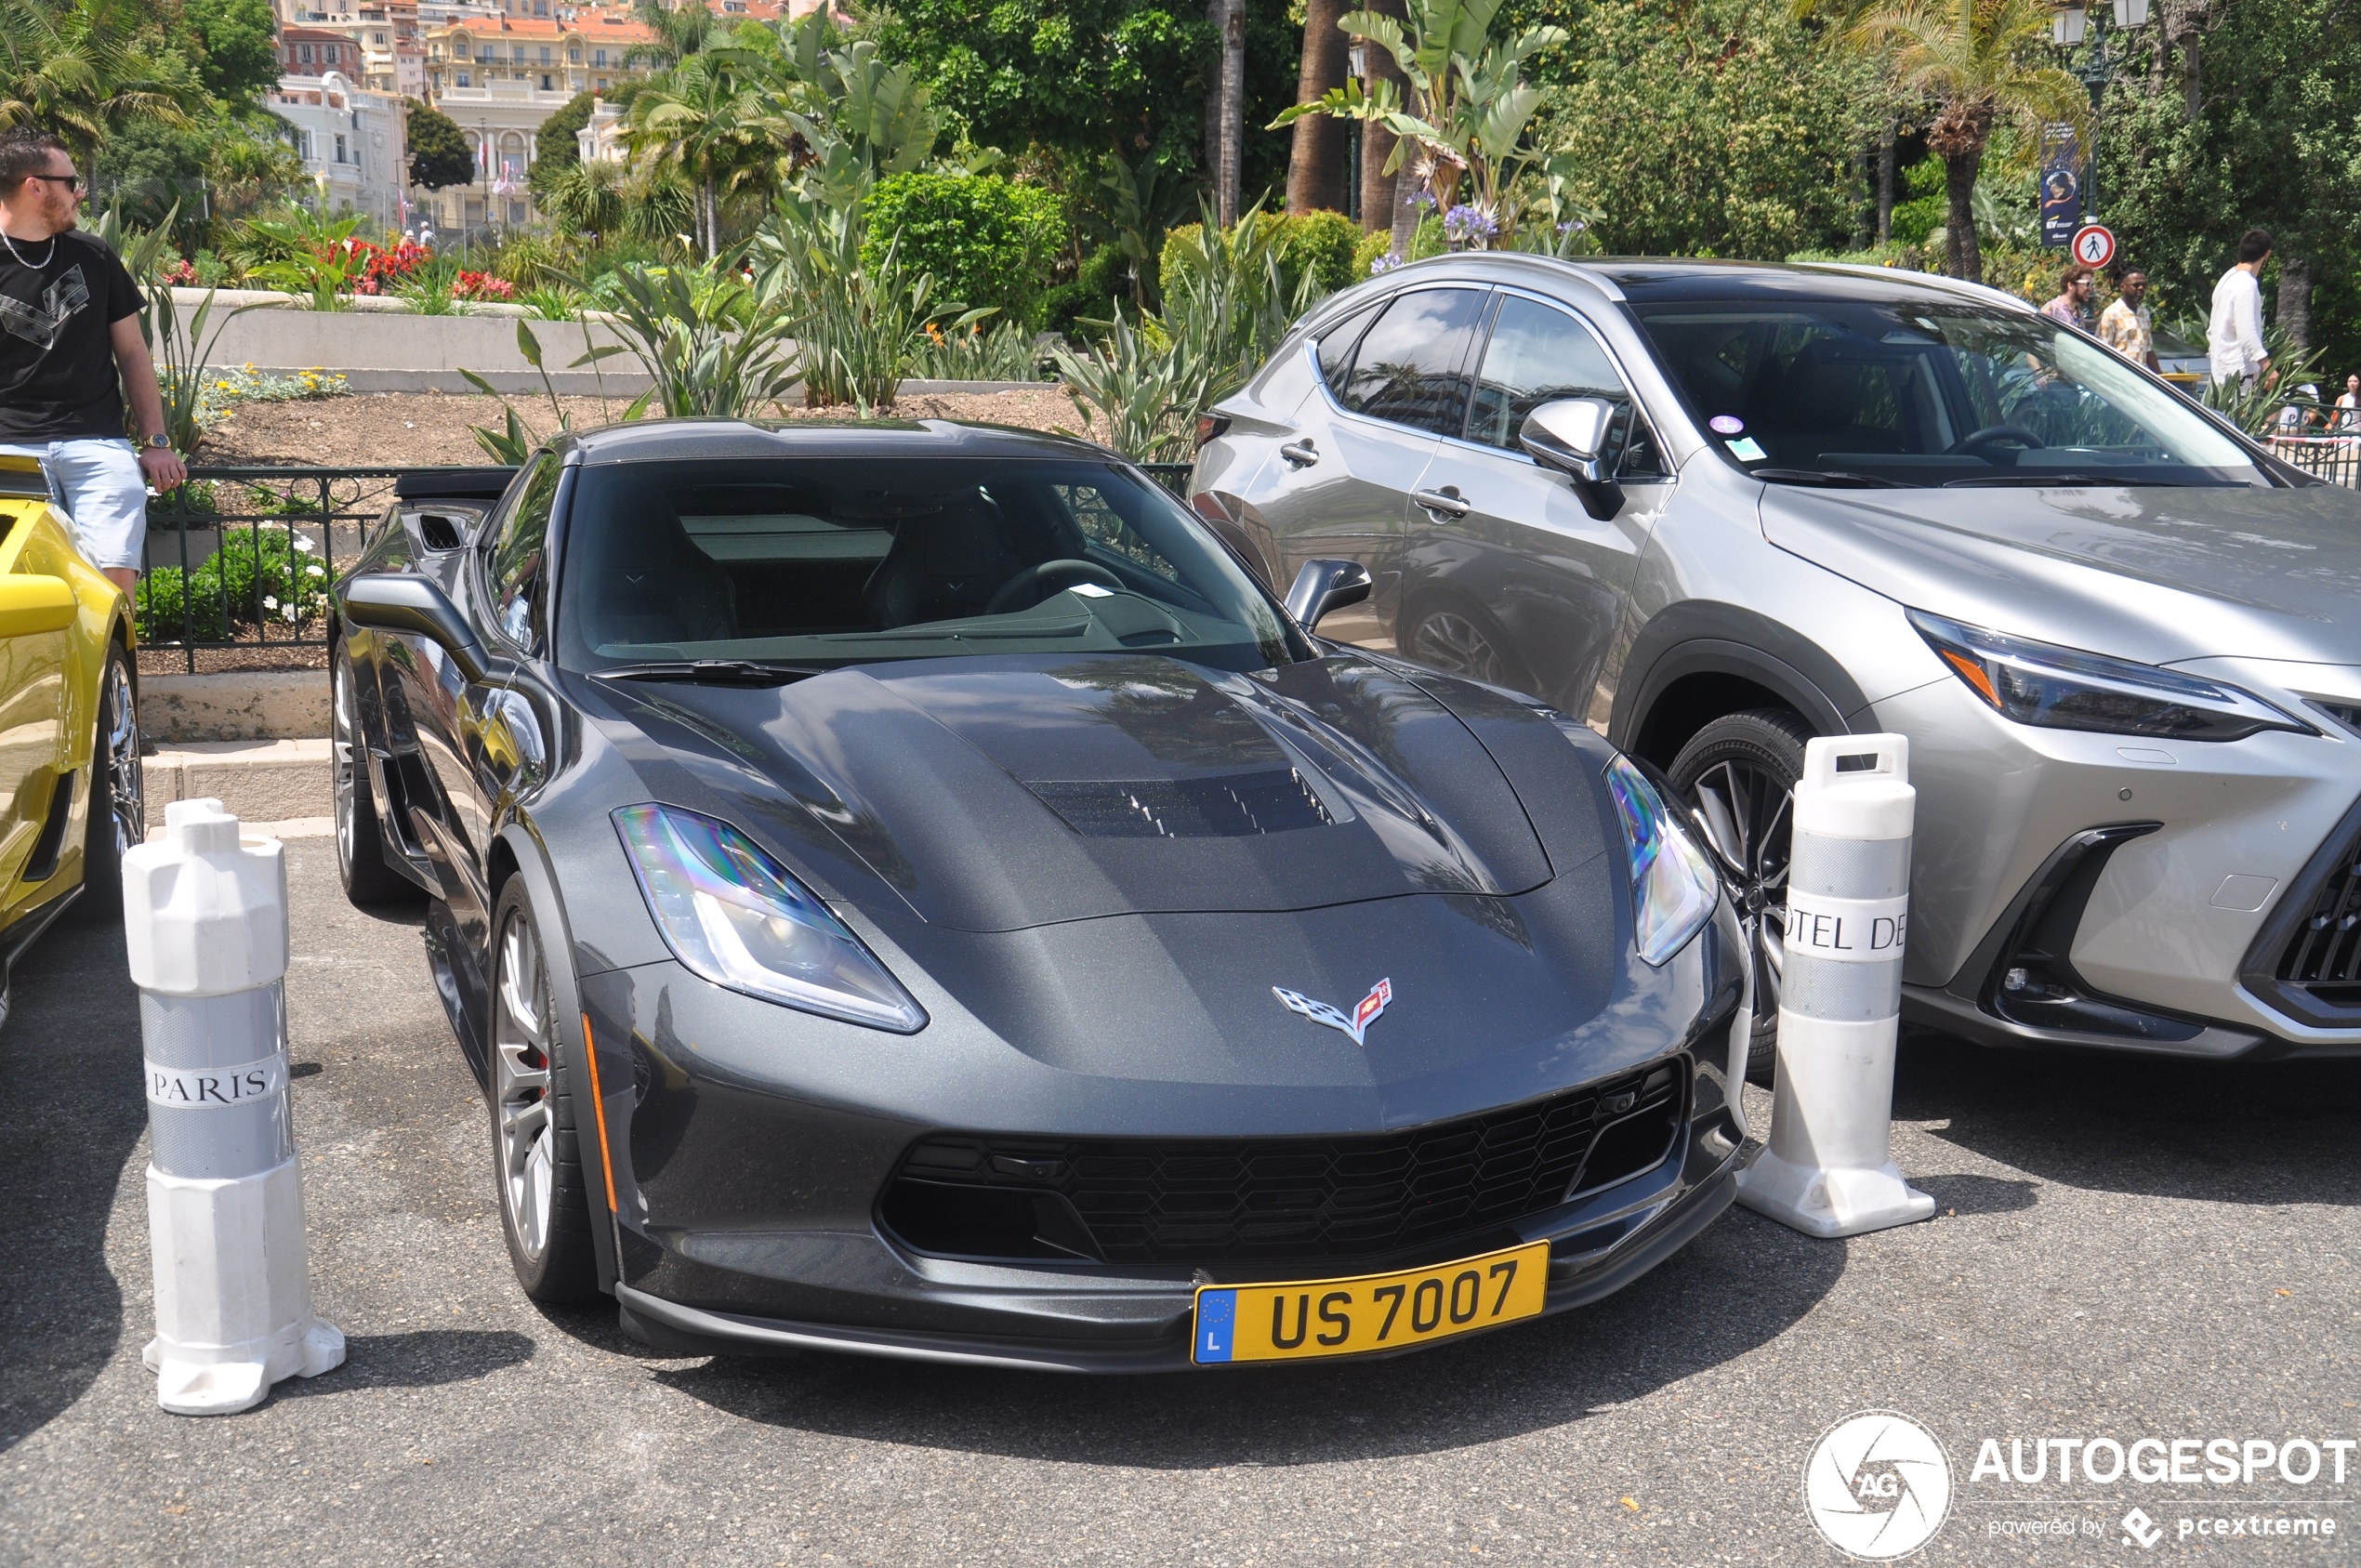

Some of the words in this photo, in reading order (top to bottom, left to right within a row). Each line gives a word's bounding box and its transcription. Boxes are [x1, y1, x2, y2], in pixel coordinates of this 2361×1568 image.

[1870, 914, 1906, 950] DE
[153, 1070, 266, 1103] PARIS
[1207, 1332, 1220, 1351] L
[1271, 1292, 1352, 1350] US
[1374, 1259, 1518, 1341] 7007
